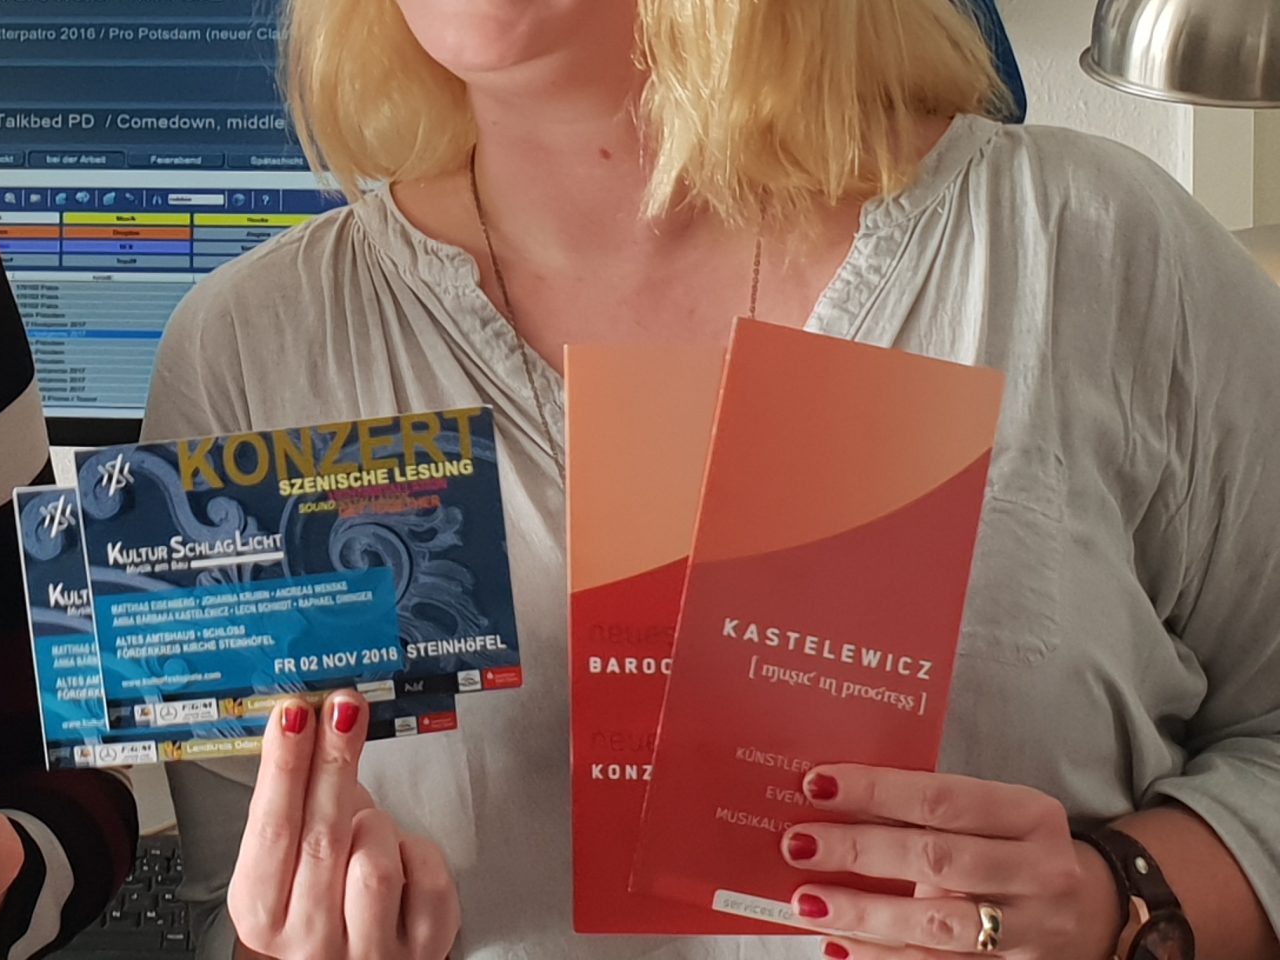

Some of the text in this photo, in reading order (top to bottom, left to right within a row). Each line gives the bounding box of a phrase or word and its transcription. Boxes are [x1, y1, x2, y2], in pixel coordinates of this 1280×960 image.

[60, 27, 95, 41] 2016
[109, 27, 134, 41] Pro
[138, 27, 201, 42] Potsdam
[206, 27, 253, 44] (neuer
[68, 113, 95, 129] PD
[116, 113, 221, 132] Comedown,
[226, 113, 286, 130] middle
[46, 155, 106, 164] bei der Arbeit
[150, 155, 202, 165] Feierabend
[176, 407, 482, 493] KONZERT
[279, 468, 390, 497] SZENISCHE
[394, 458, 475, 484] LESUNG
[154, 562, 168, 573] am
[171, 560, 189, 571] Bau
[723, 617, 933, 680] KASTELEWICZ
[274, 646, 398, 674] FR 02 NOV 2018
[762, 663, 916, 712] music in progress
[722, 896, 774, 918] services
